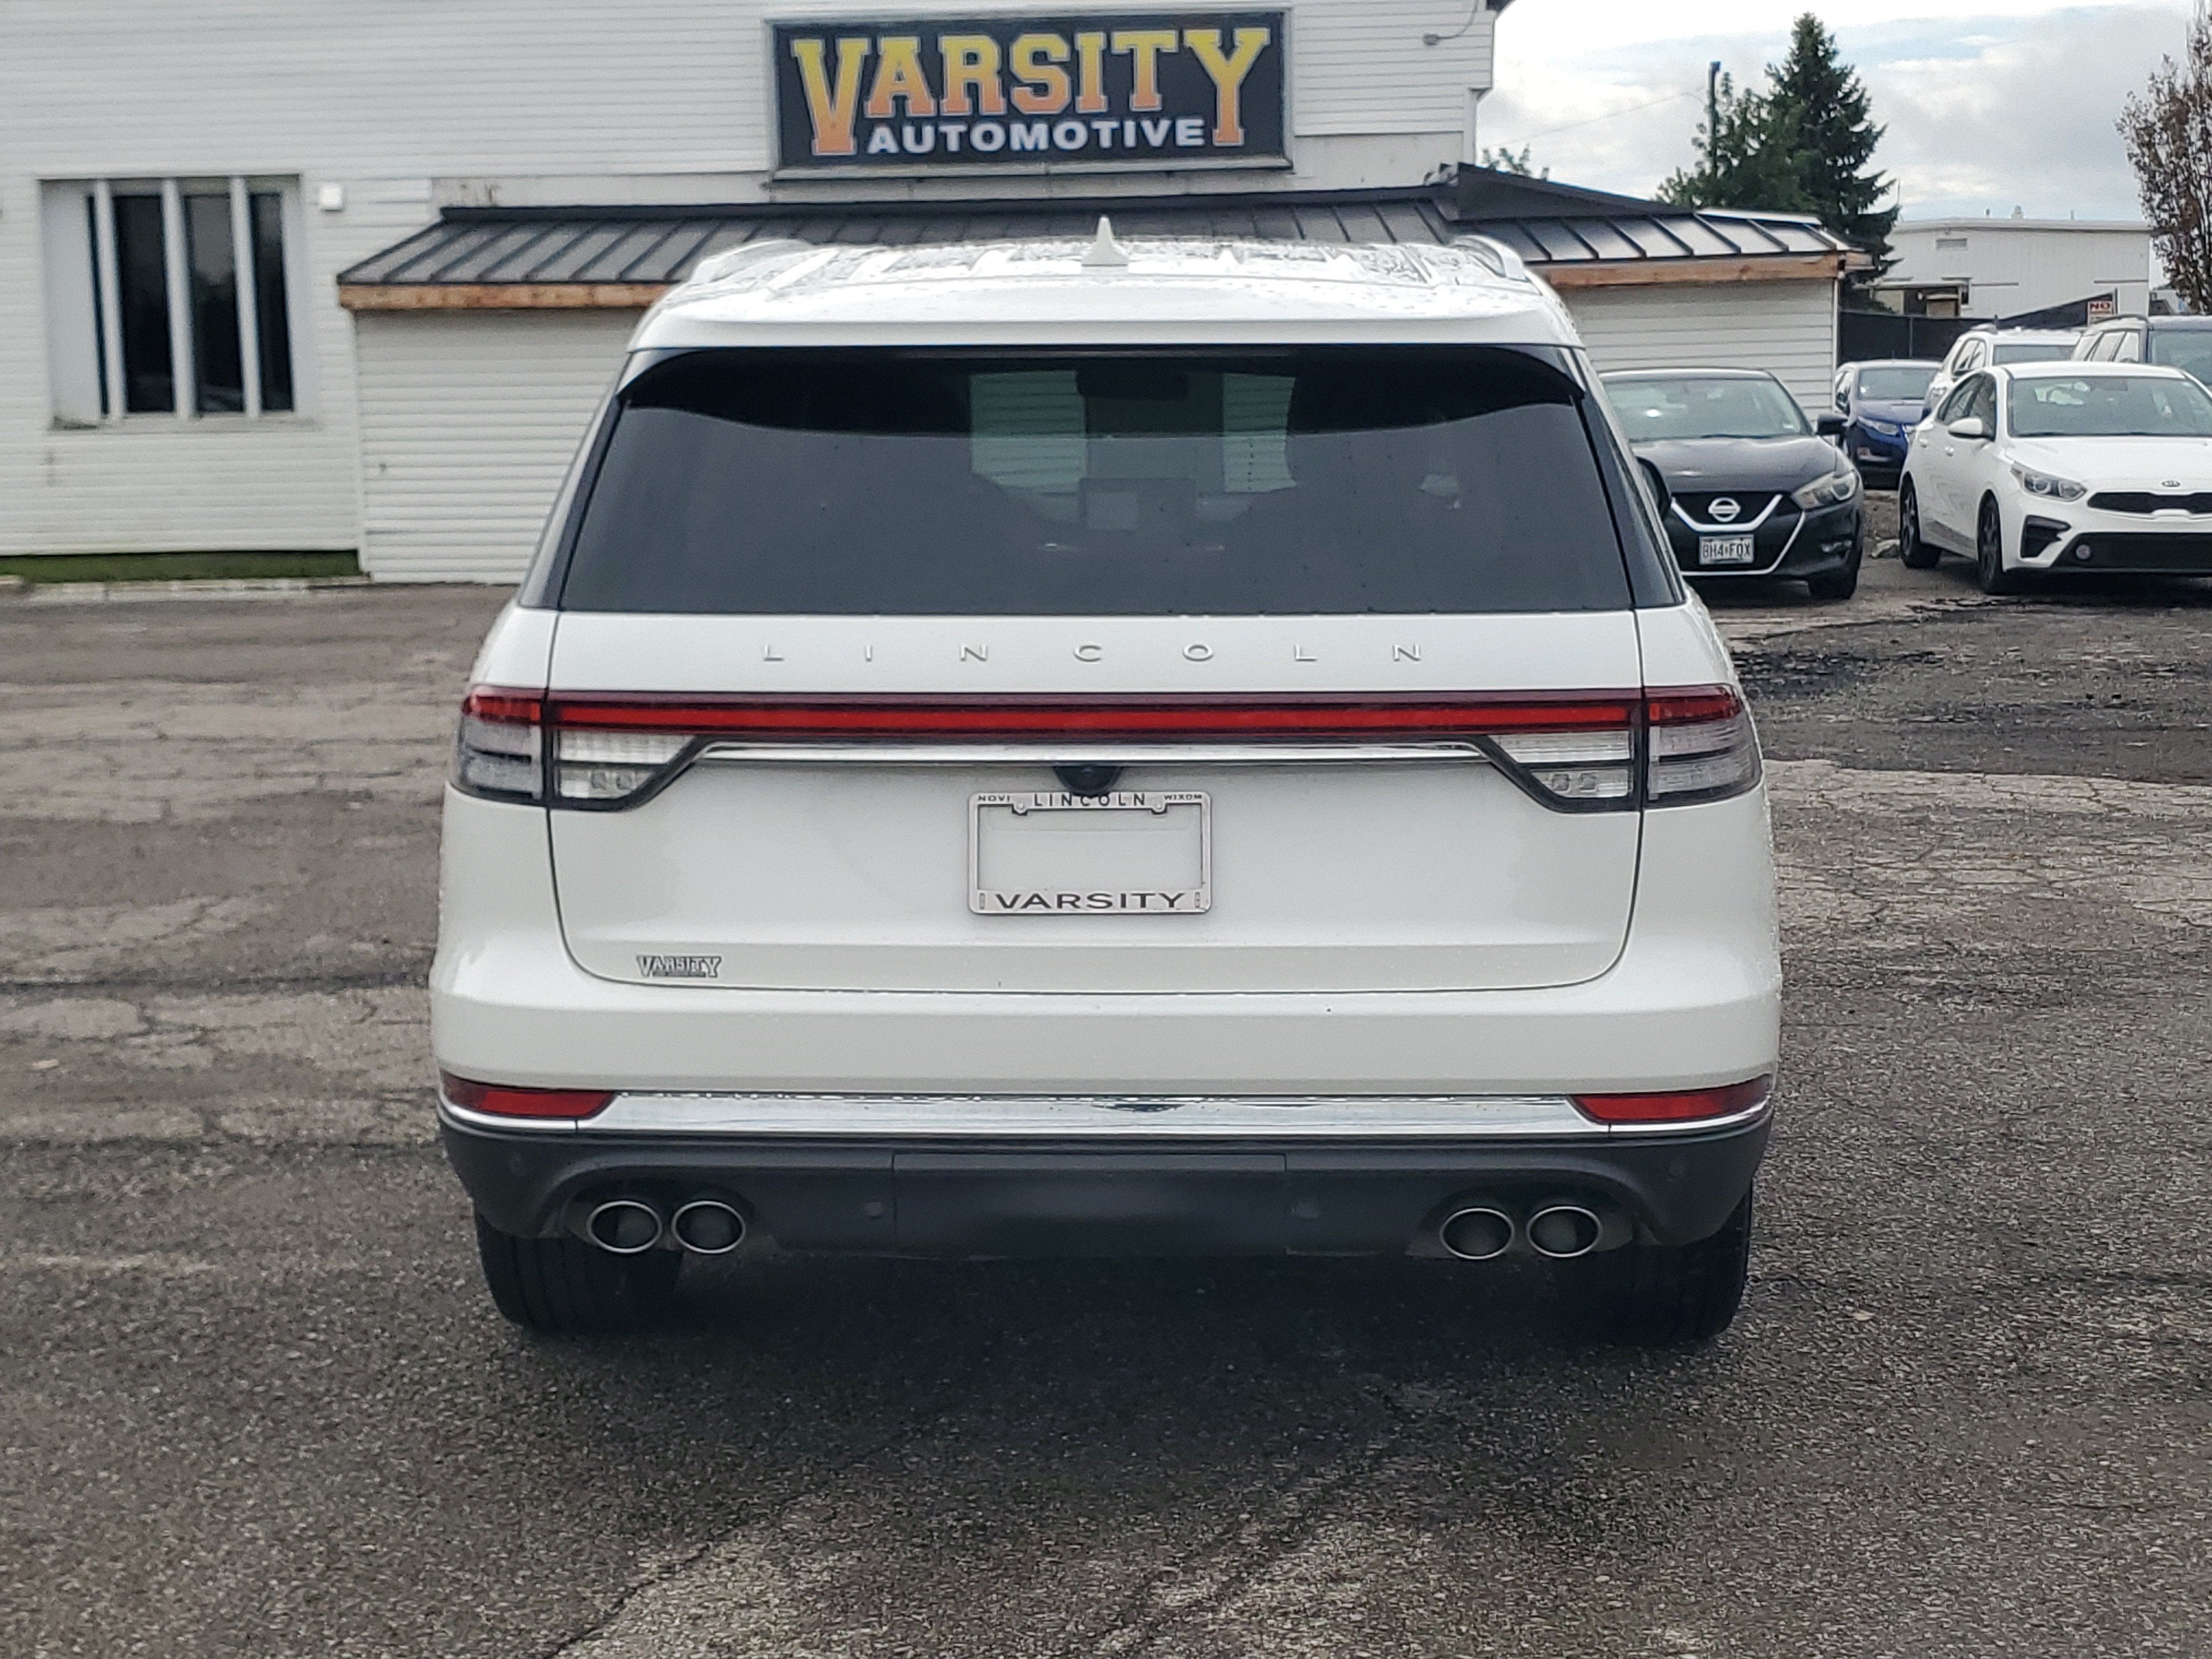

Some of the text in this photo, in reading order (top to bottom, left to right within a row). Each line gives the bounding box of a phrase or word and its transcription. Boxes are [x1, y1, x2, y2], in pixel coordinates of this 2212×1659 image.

[791, 27, 1271, 155] VARSITY
[867, 119, 1204, 154] AUTOMOTIVE
[763, 644, 1423, 662] LINCOLN
[1034, 793, 1146, 806] LINCOLN
[996, 893, 1185, 909] VARSITY
[636, 956, 721, 977] VARSITY
